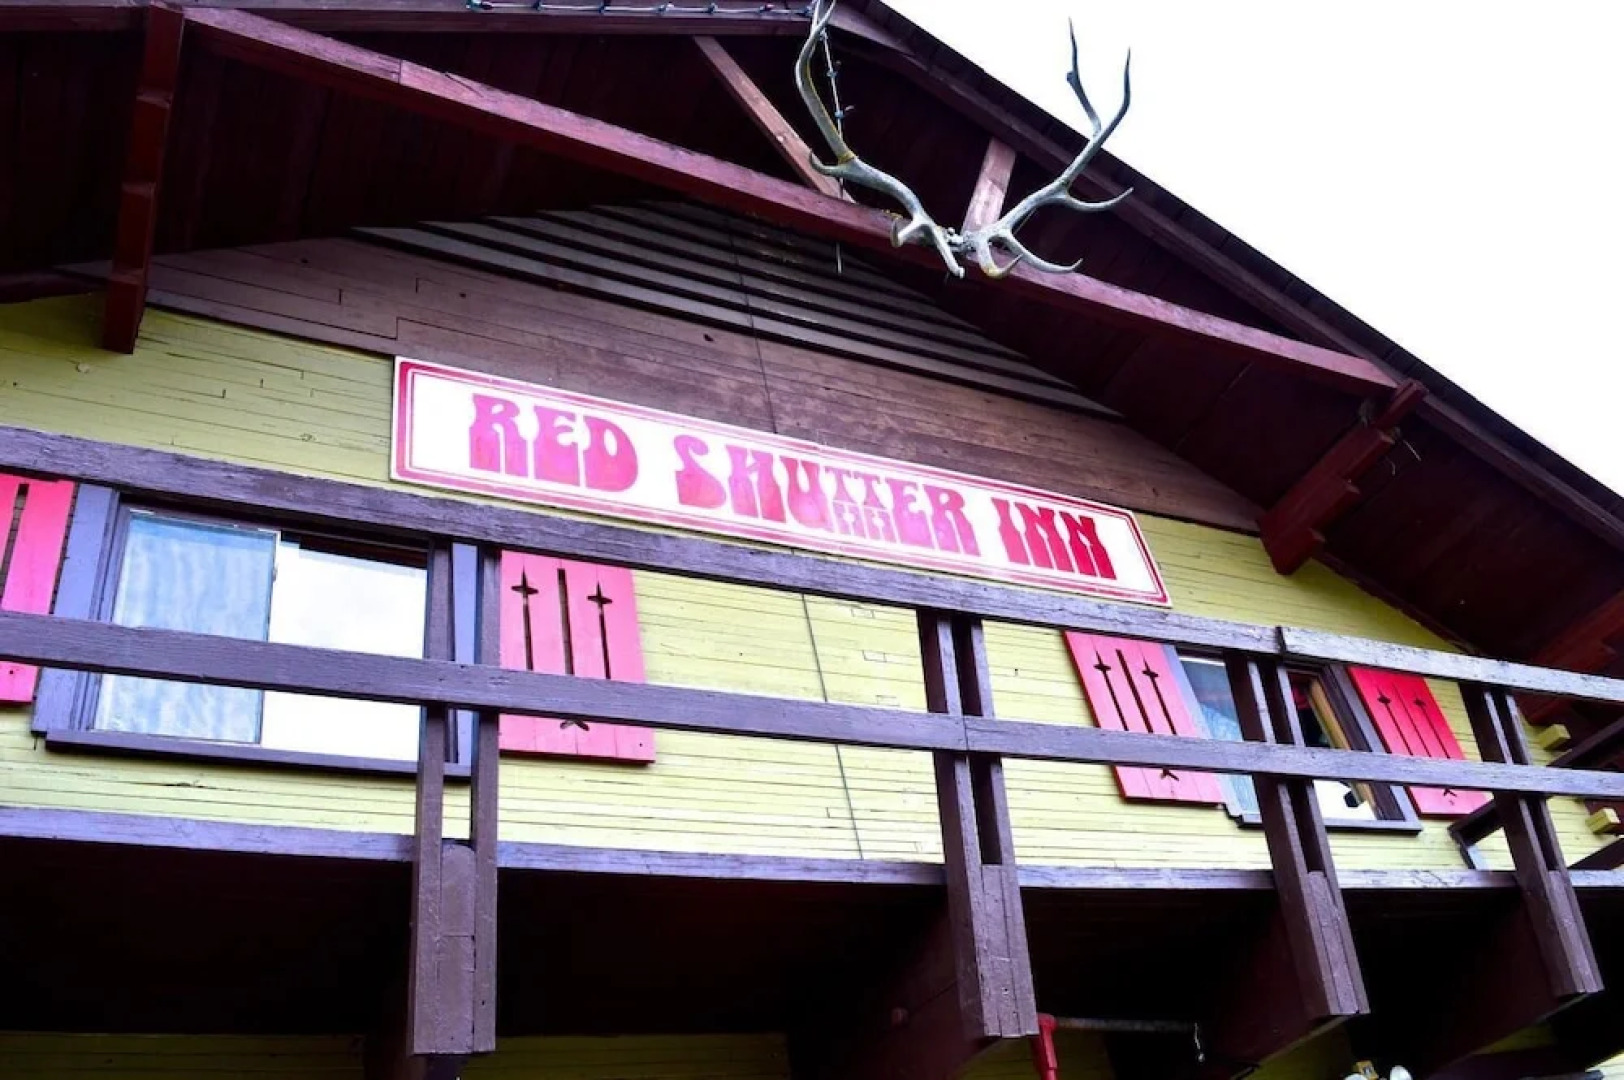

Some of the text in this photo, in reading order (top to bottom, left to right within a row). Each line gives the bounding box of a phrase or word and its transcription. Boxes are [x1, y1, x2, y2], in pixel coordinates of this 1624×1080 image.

[469, 393, 1118, 581] RED SHUTTER INN
